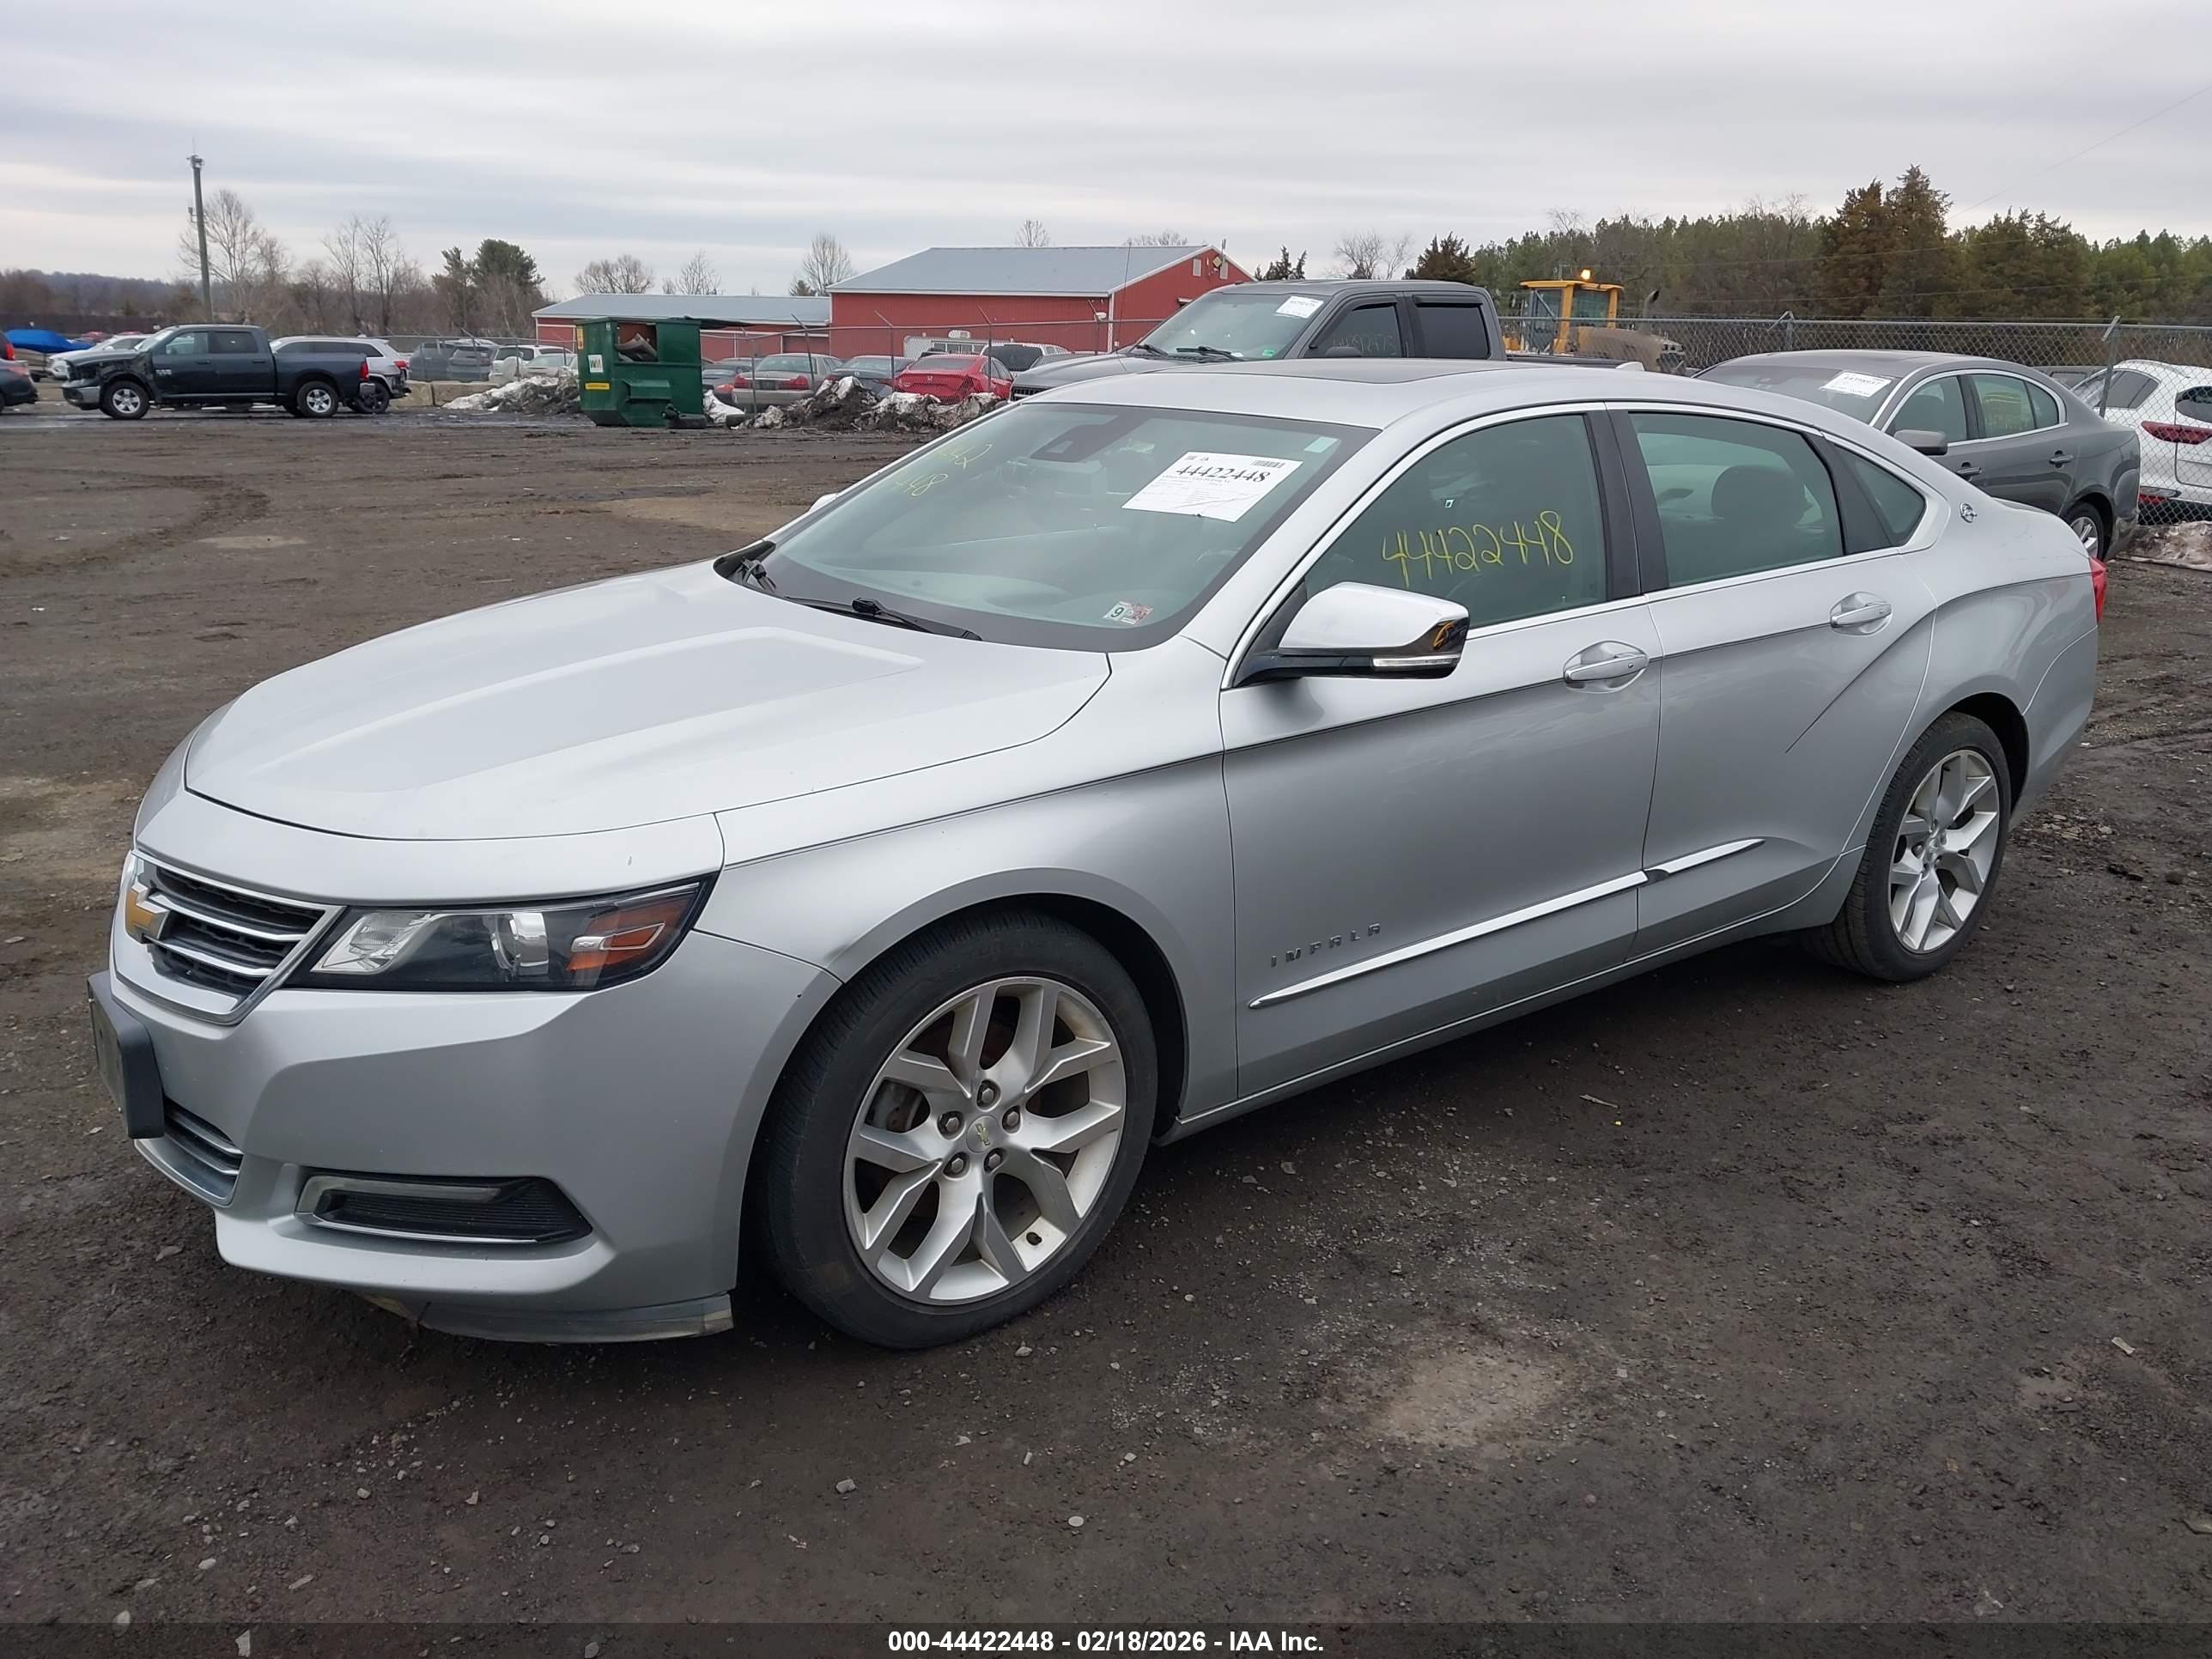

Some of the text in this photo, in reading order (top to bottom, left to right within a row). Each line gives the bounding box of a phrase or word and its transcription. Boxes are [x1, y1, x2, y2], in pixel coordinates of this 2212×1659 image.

[1176, 465, 1271, 483] 44422448
[1382, 510, 1574, 588] 44422448
[1110, 606, 1125, 618] 9
[1270, 922, 1381, 968] IMPALA
